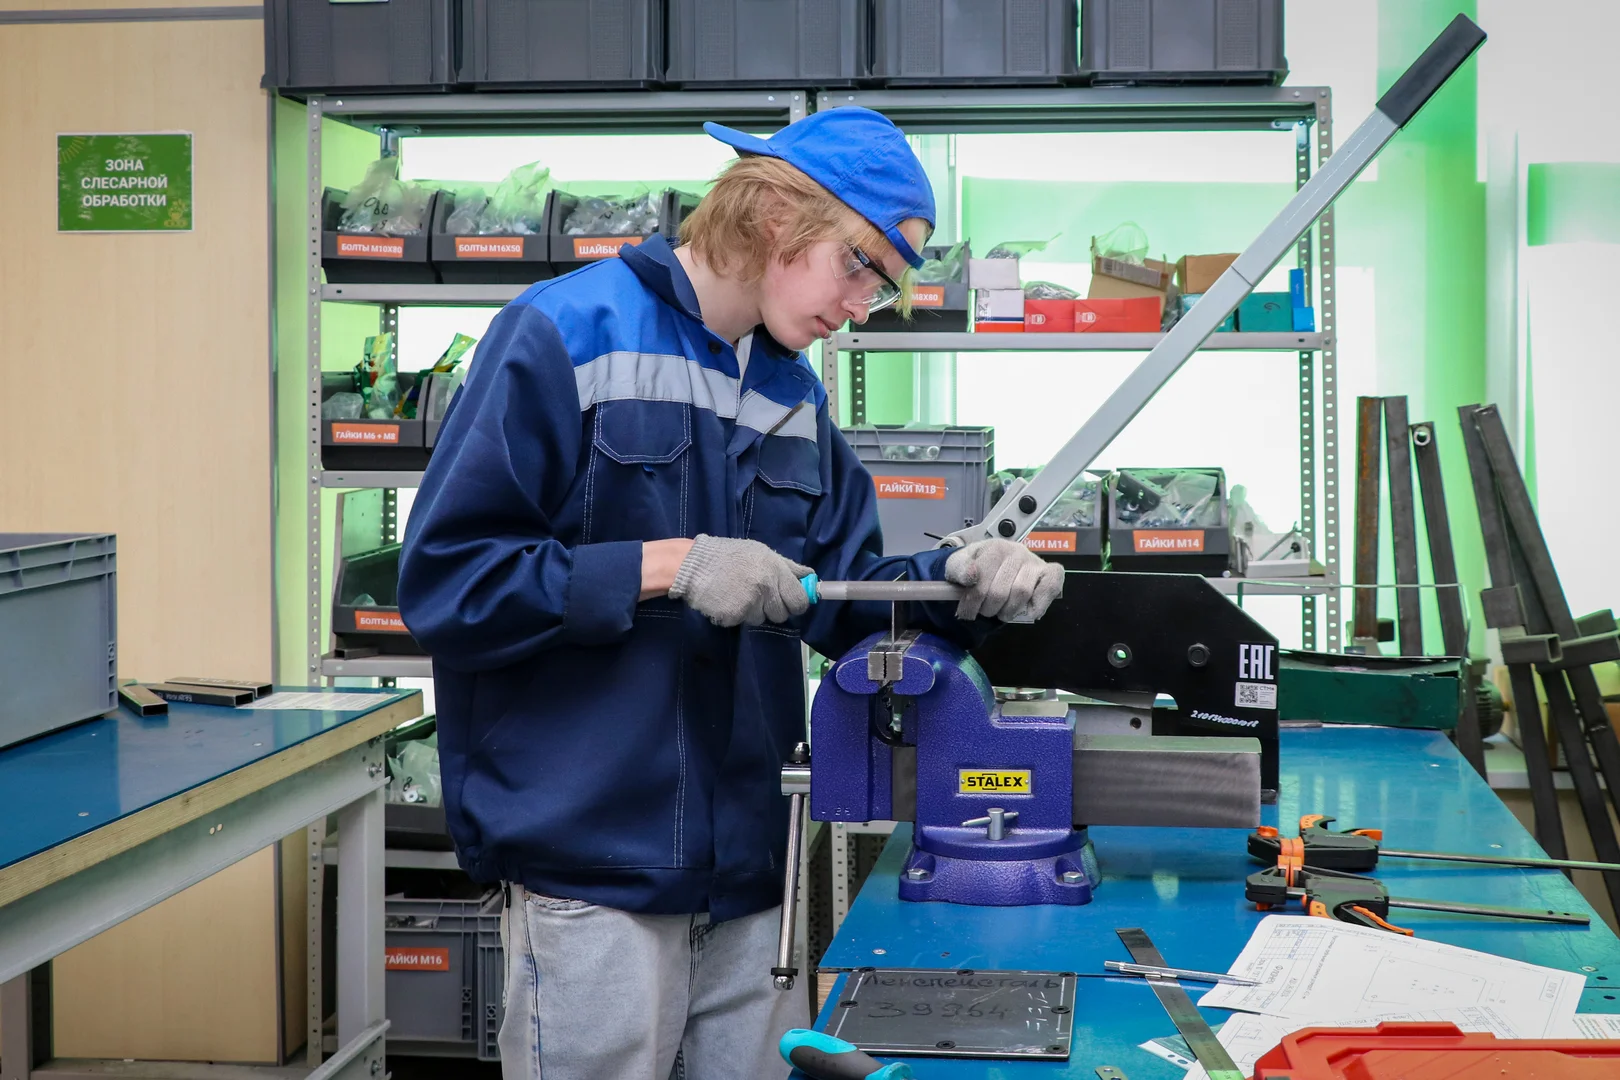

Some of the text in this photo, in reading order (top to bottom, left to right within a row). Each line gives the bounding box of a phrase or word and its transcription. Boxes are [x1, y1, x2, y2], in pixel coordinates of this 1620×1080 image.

[105, 159, 144, 171] ЗОНА
[81, 173, 168, 189] СЛЕСАРНОЙ
[82, 194, 167, 207] ОБРАБОТКИ
[341, 243, 370, 252] БОЛТЫ
[458, 244, 488, 252] БОЛТЫ
[578, 243, 618, 255] ШАЙБЫ
[335, 430, 362, 439] ГАЙКИ
[880, 482, 937, 494] ГАЙКИ М18
[1022, 537, 1070, 549] ЙКИ М14
[1139, 537, 1200, 549] ГАЙКИ М14
[360, 617, 389, 626] БОЛТЫ
[1239, 644, 1275, 680] EAC
[967, 774, 1023, 790] STALEX
[384, 953, 443, 965] ГАЙКИ М16
